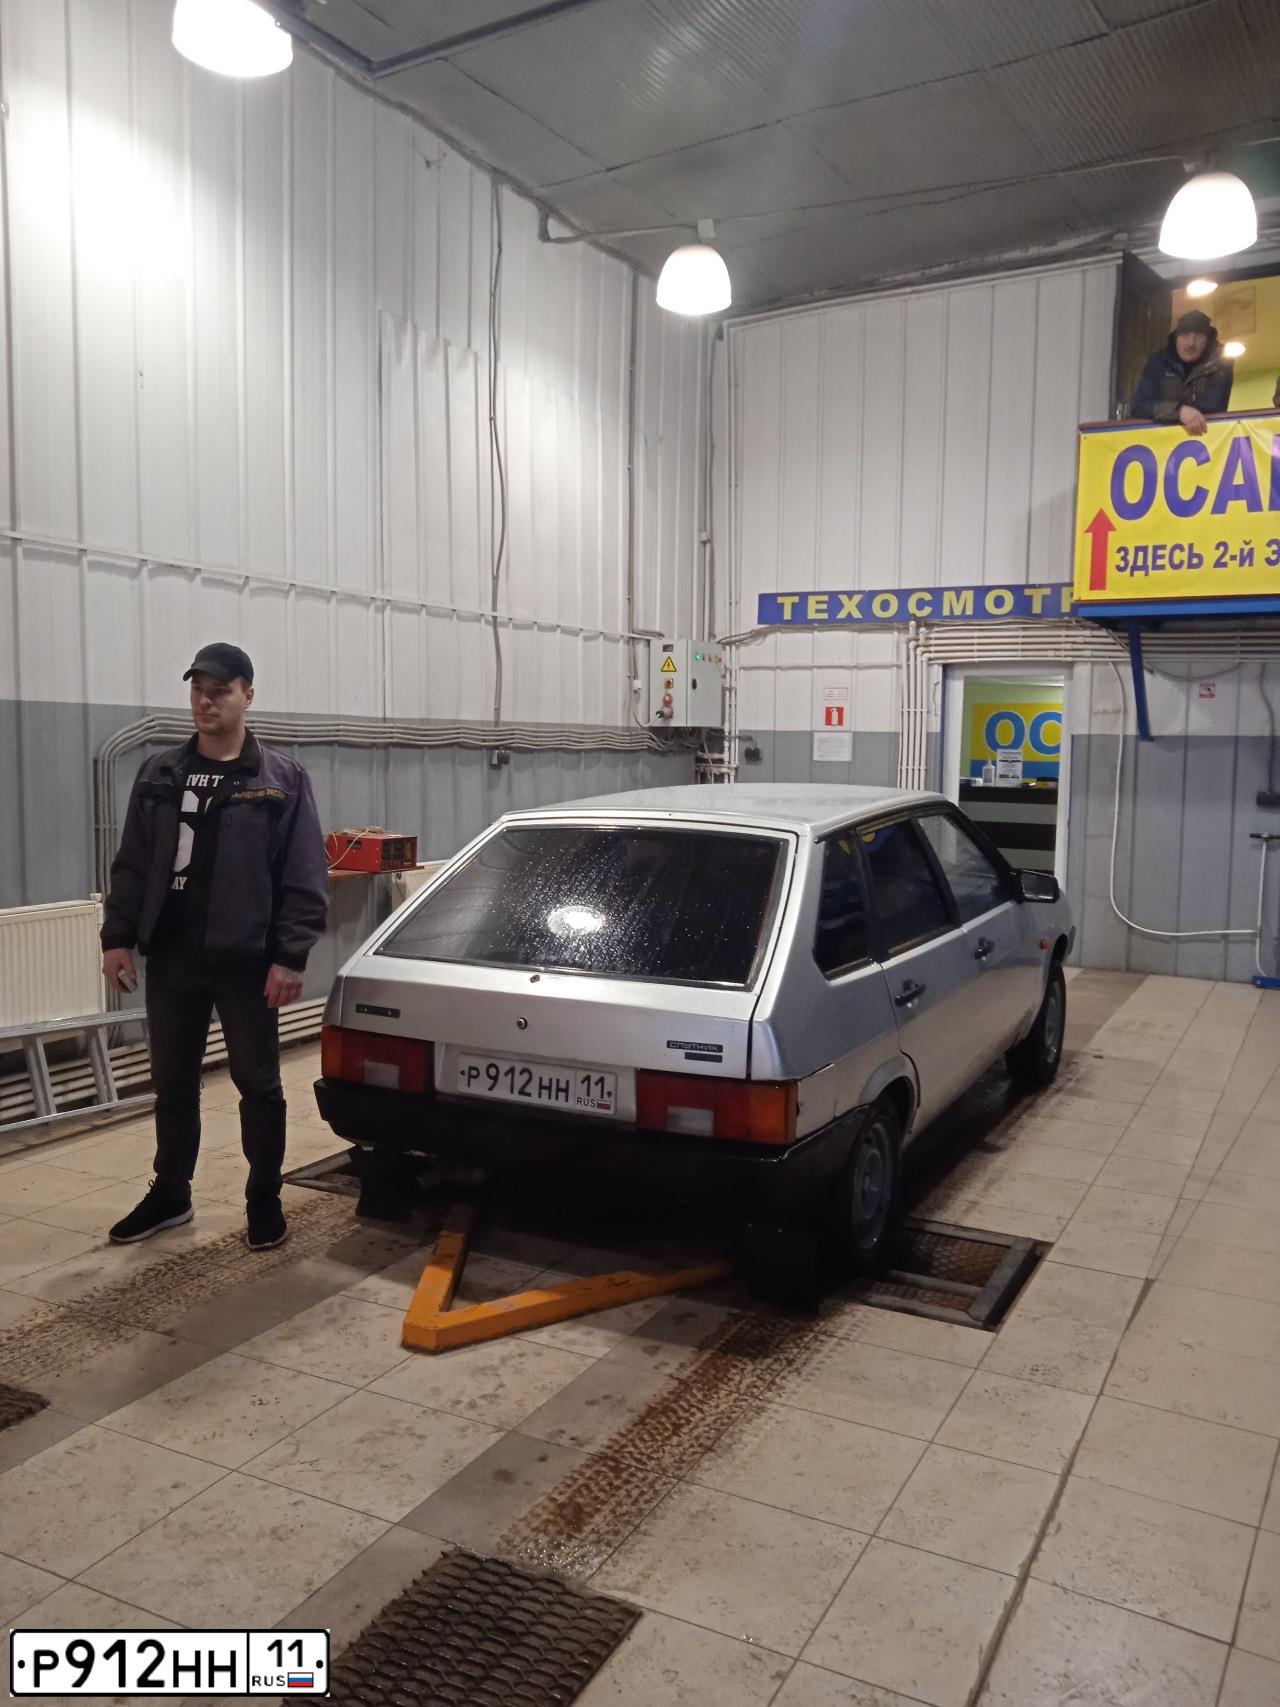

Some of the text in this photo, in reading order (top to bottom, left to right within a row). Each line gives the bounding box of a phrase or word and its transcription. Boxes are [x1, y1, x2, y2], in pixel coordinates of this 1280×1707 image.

[1110, 434, 1280, 521] ОСА
[1115, 543, 1204, 577] ЗДЕСЬ
[1213, 539, 1255, 569] 2-й
[466, 1062, 606, 1102] Р912НН 11
[576, 1096, 596, 1108] RUS
